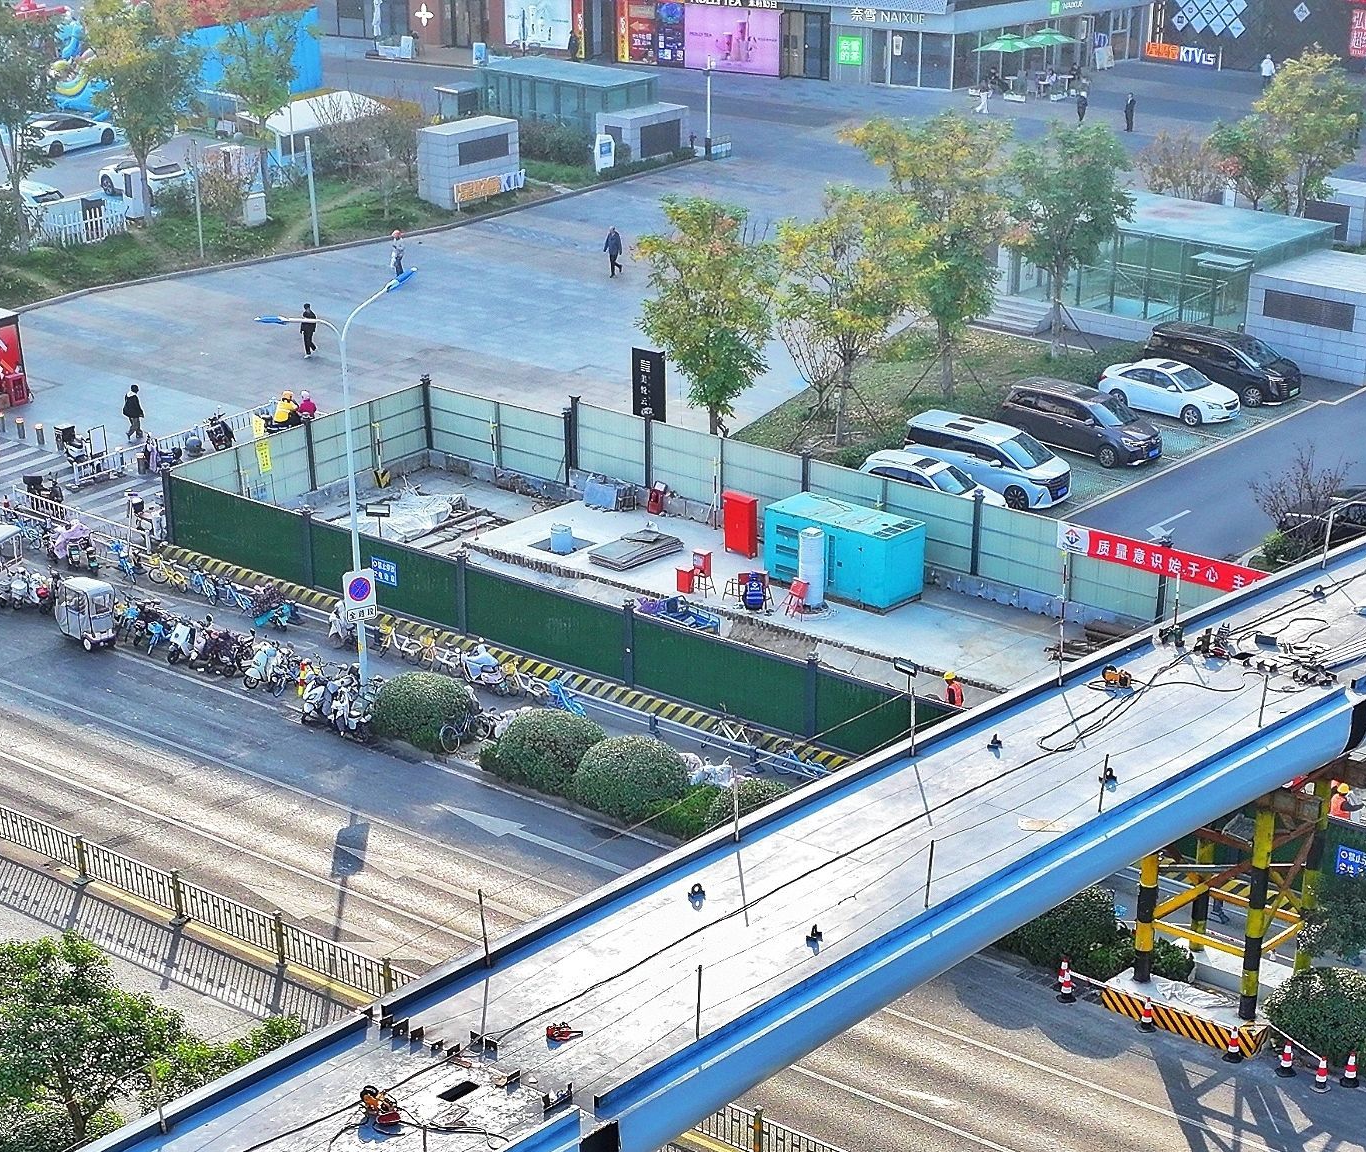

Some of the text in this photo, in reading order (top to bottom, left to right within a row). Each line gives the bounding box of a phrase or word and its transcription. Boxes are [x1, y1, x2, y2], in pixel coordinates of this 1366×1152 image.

[851, 8, 925, 25] 奈雪 NAIXUE
[1096, 540, 1219, 583] 质量意识始于心
